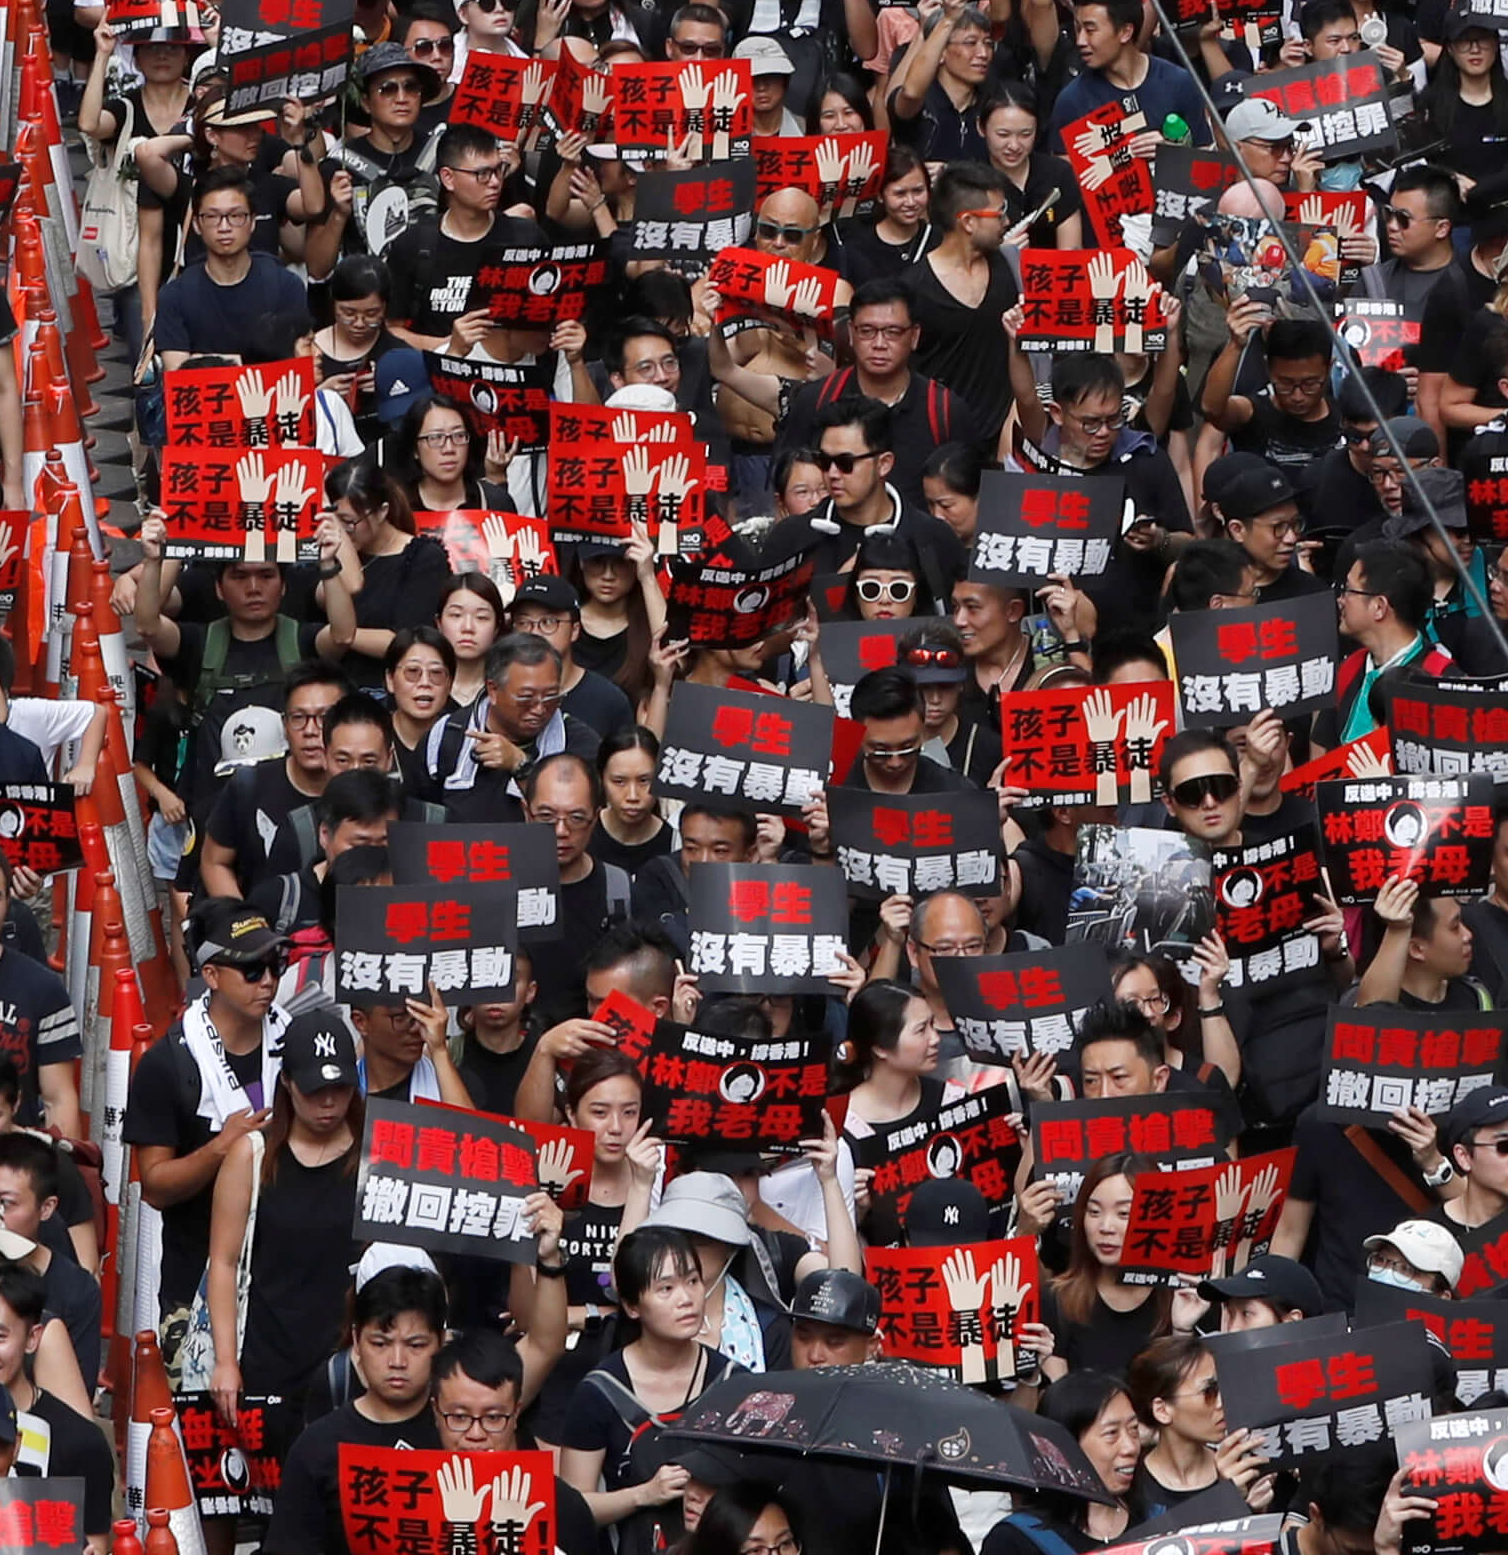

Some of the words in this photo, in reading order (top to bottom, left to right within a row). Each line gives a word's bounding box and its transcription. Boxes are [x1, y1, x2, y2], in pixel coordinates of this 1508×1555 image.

[619, 75, 676, 105] 孩子
[446, 275, 471, 289] THE
[1024, 261, 1086, 294] 孩子
[1023, 295, 1163, 328] 不是暴徒！
[554, 456, 619, 491] 孩子
[1019, 488, 1092, 529] 學生
[976, 531, 1110, 578] 沒有暴動
[1217, 617, 1297, 664] 學生
[1181, 656, 1335, 714] 沒有暴動
[712, 704, 792, 758] 學生
[1009, 705, 1081, 743] 孩子
[658, 744, 826, 808] 沒有暴動
[871, 806, 954, 848] 學生
[425, 839, 511, 884] 學生
[836, 844, 996, 893] 沒有暴動
[384, 899, 472, 945] 學生
[729, 878, 813, 925] 學生
[339, 946, 512, 995] 沒有暴動
[690, 930, 849, 978] 沒有暴動
[1138, 1185, 1211, 1224] 孩子
[873, 1266, 939, 1306] 孩子
[1277, 1351, 1378, 1409] 學生
[348, 1465, 434, 1510] 孩子
